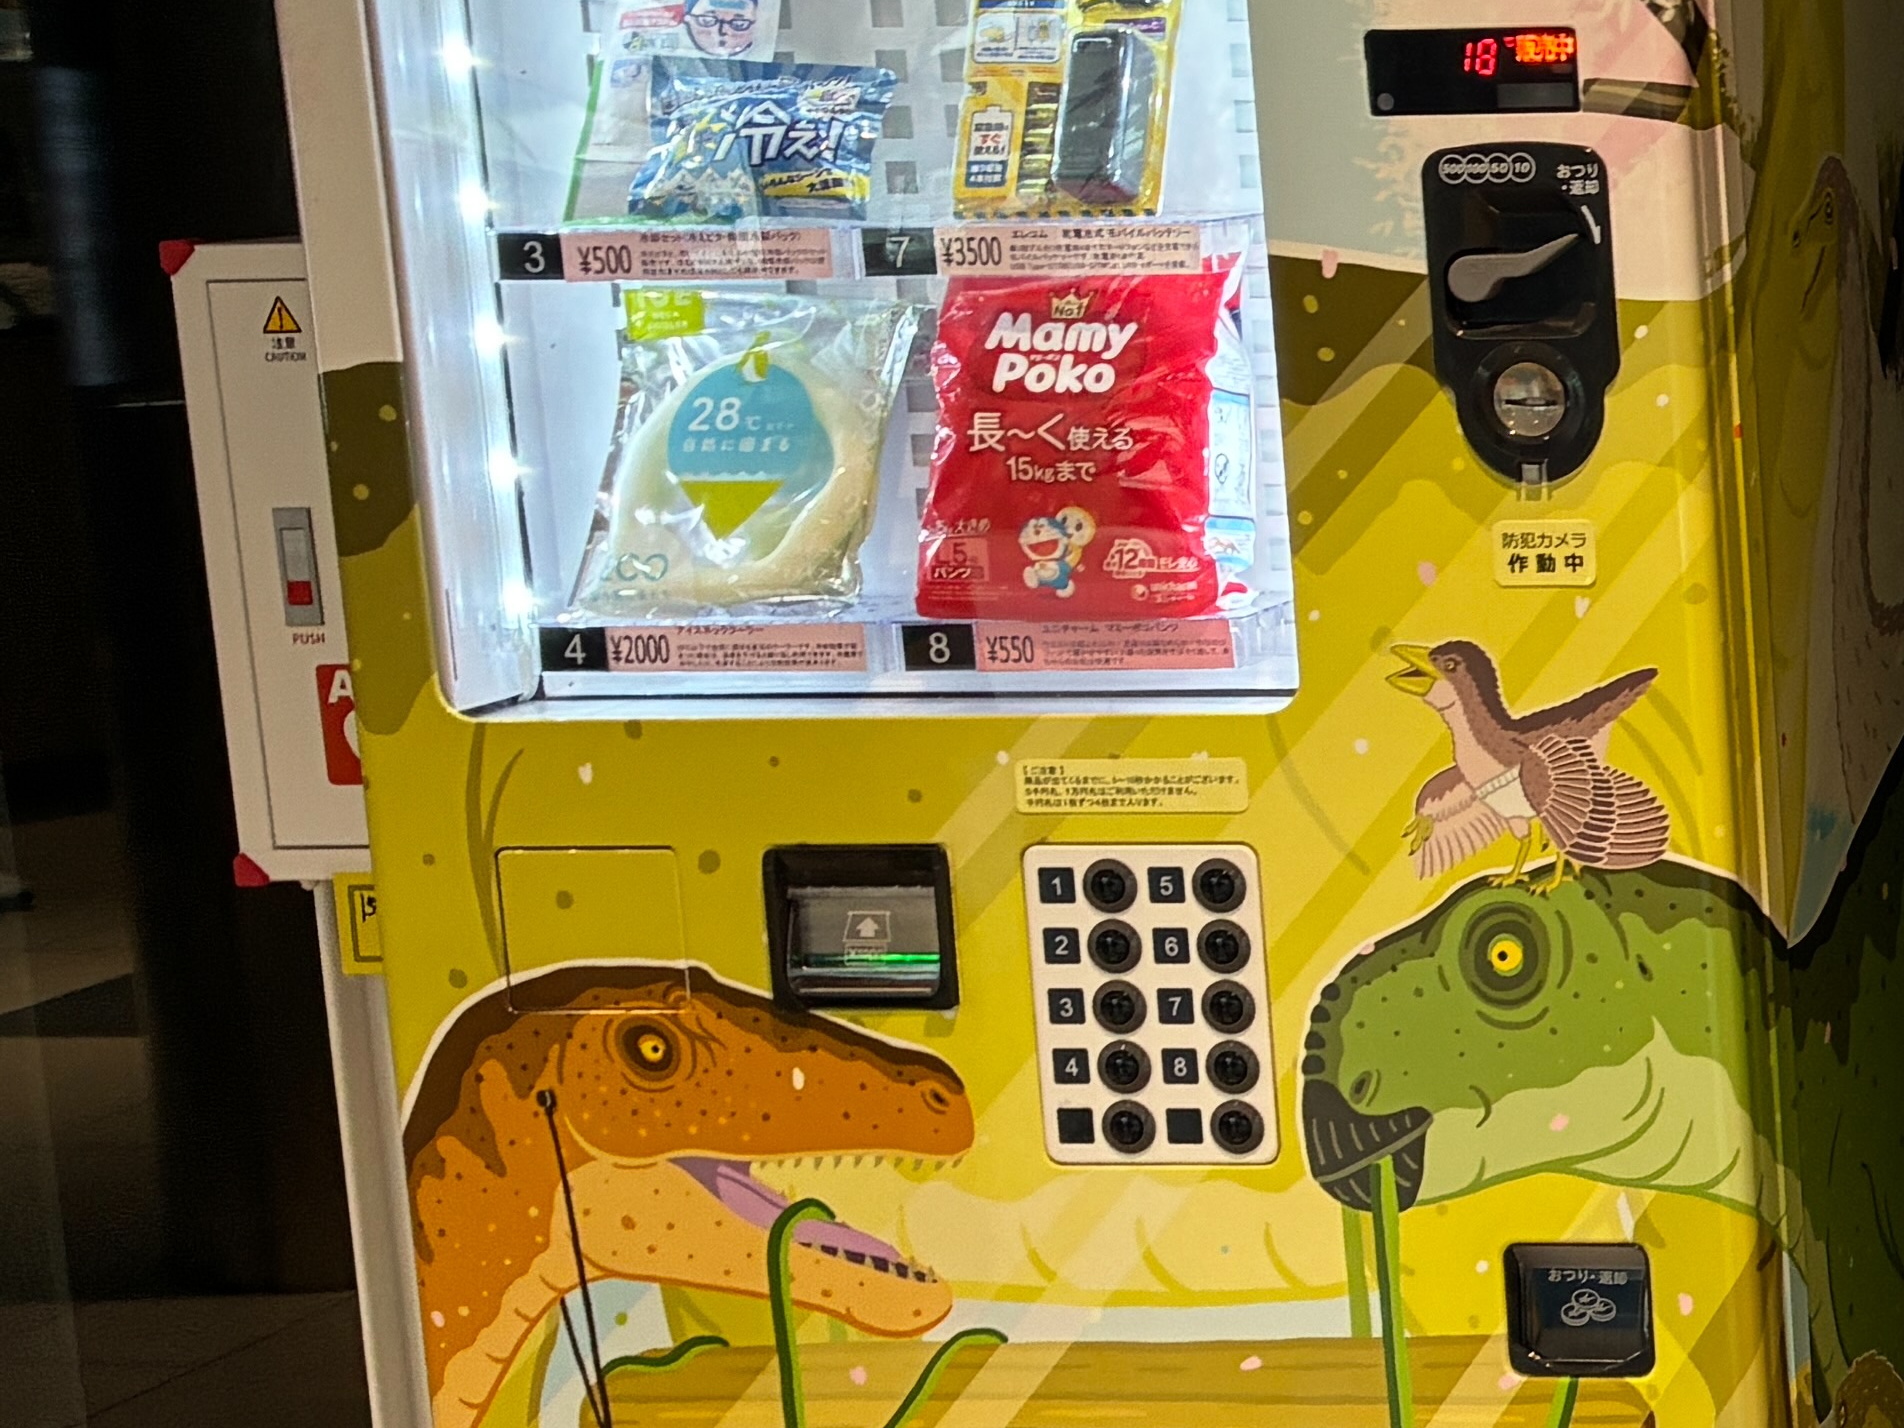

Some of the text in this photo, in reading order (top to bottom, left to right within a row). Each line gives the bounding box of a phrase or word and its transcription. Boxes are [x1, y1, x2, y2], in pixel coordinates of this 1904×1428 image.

[577, 246, 632, 276] ¥500
[941, 236, 1001, 267] ¥3500
[985, 312, 1138, 360] Mamy
[992, 353, 1116, 393] Poko
[1006, 457, 1096, 483] 15kgまで
[1502, 532, 1587, 549] 防犯カメラ
[1506, 553, 1585, 575] 作動中
[292, 633, 326, 646] PUSH
[611, 634, 670, 664] ¥2000
[986, 636, 1034, 664] ¥550
[1160, 876, 1174, 896] 5
